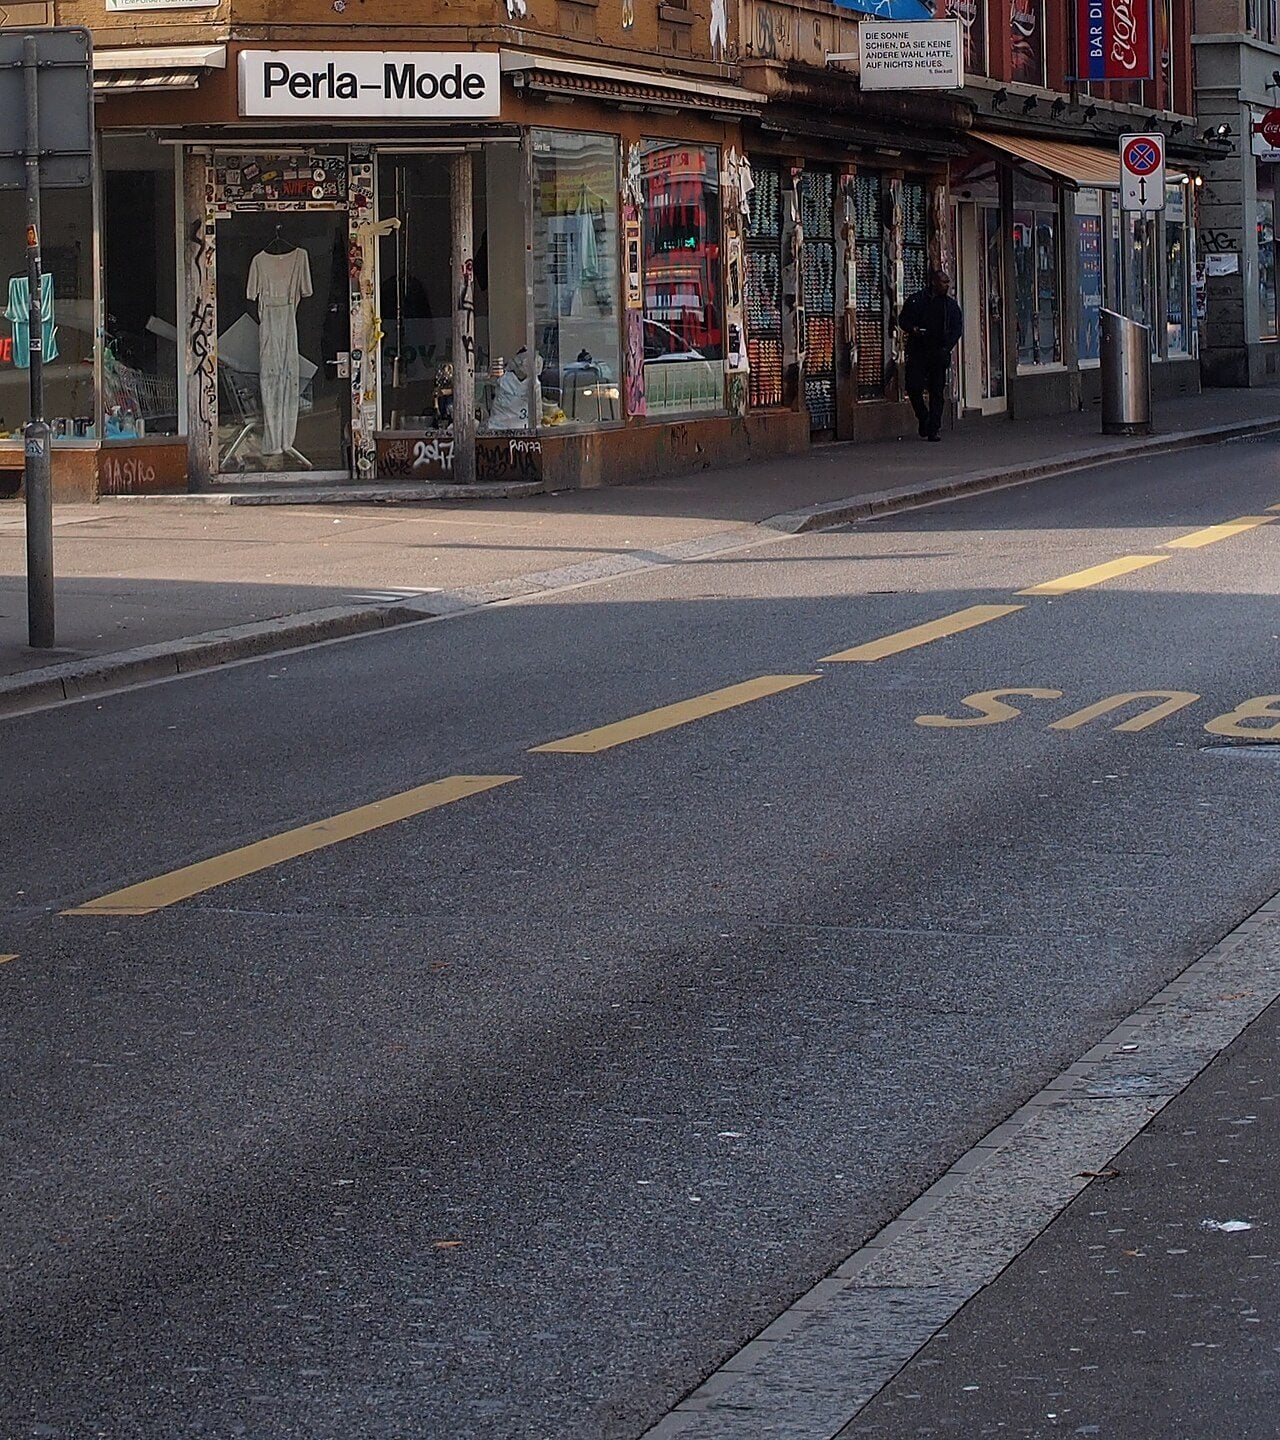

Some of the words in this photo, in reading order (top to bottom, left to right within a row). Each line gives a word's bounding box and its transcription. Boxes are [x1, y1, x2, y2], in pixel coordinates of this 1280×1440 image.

[866, 32, 879, 40] DIE
[881, 32, 909, 40] SONNE
[900, 41, 911, 49] DA
[913, 41, 926, 49] SIE
[928, 40, 951, 48] KEINE
[1090, 26, 1103, 57] BAR
[866, 51, 898, 59] ANDERE
[901, 50, 924, 58] WAHL
[866, 61, 882, 69] AUF
[884, 60, 913, 69] NICHTS
[264, 62, 485, 100] Perla-Mode
